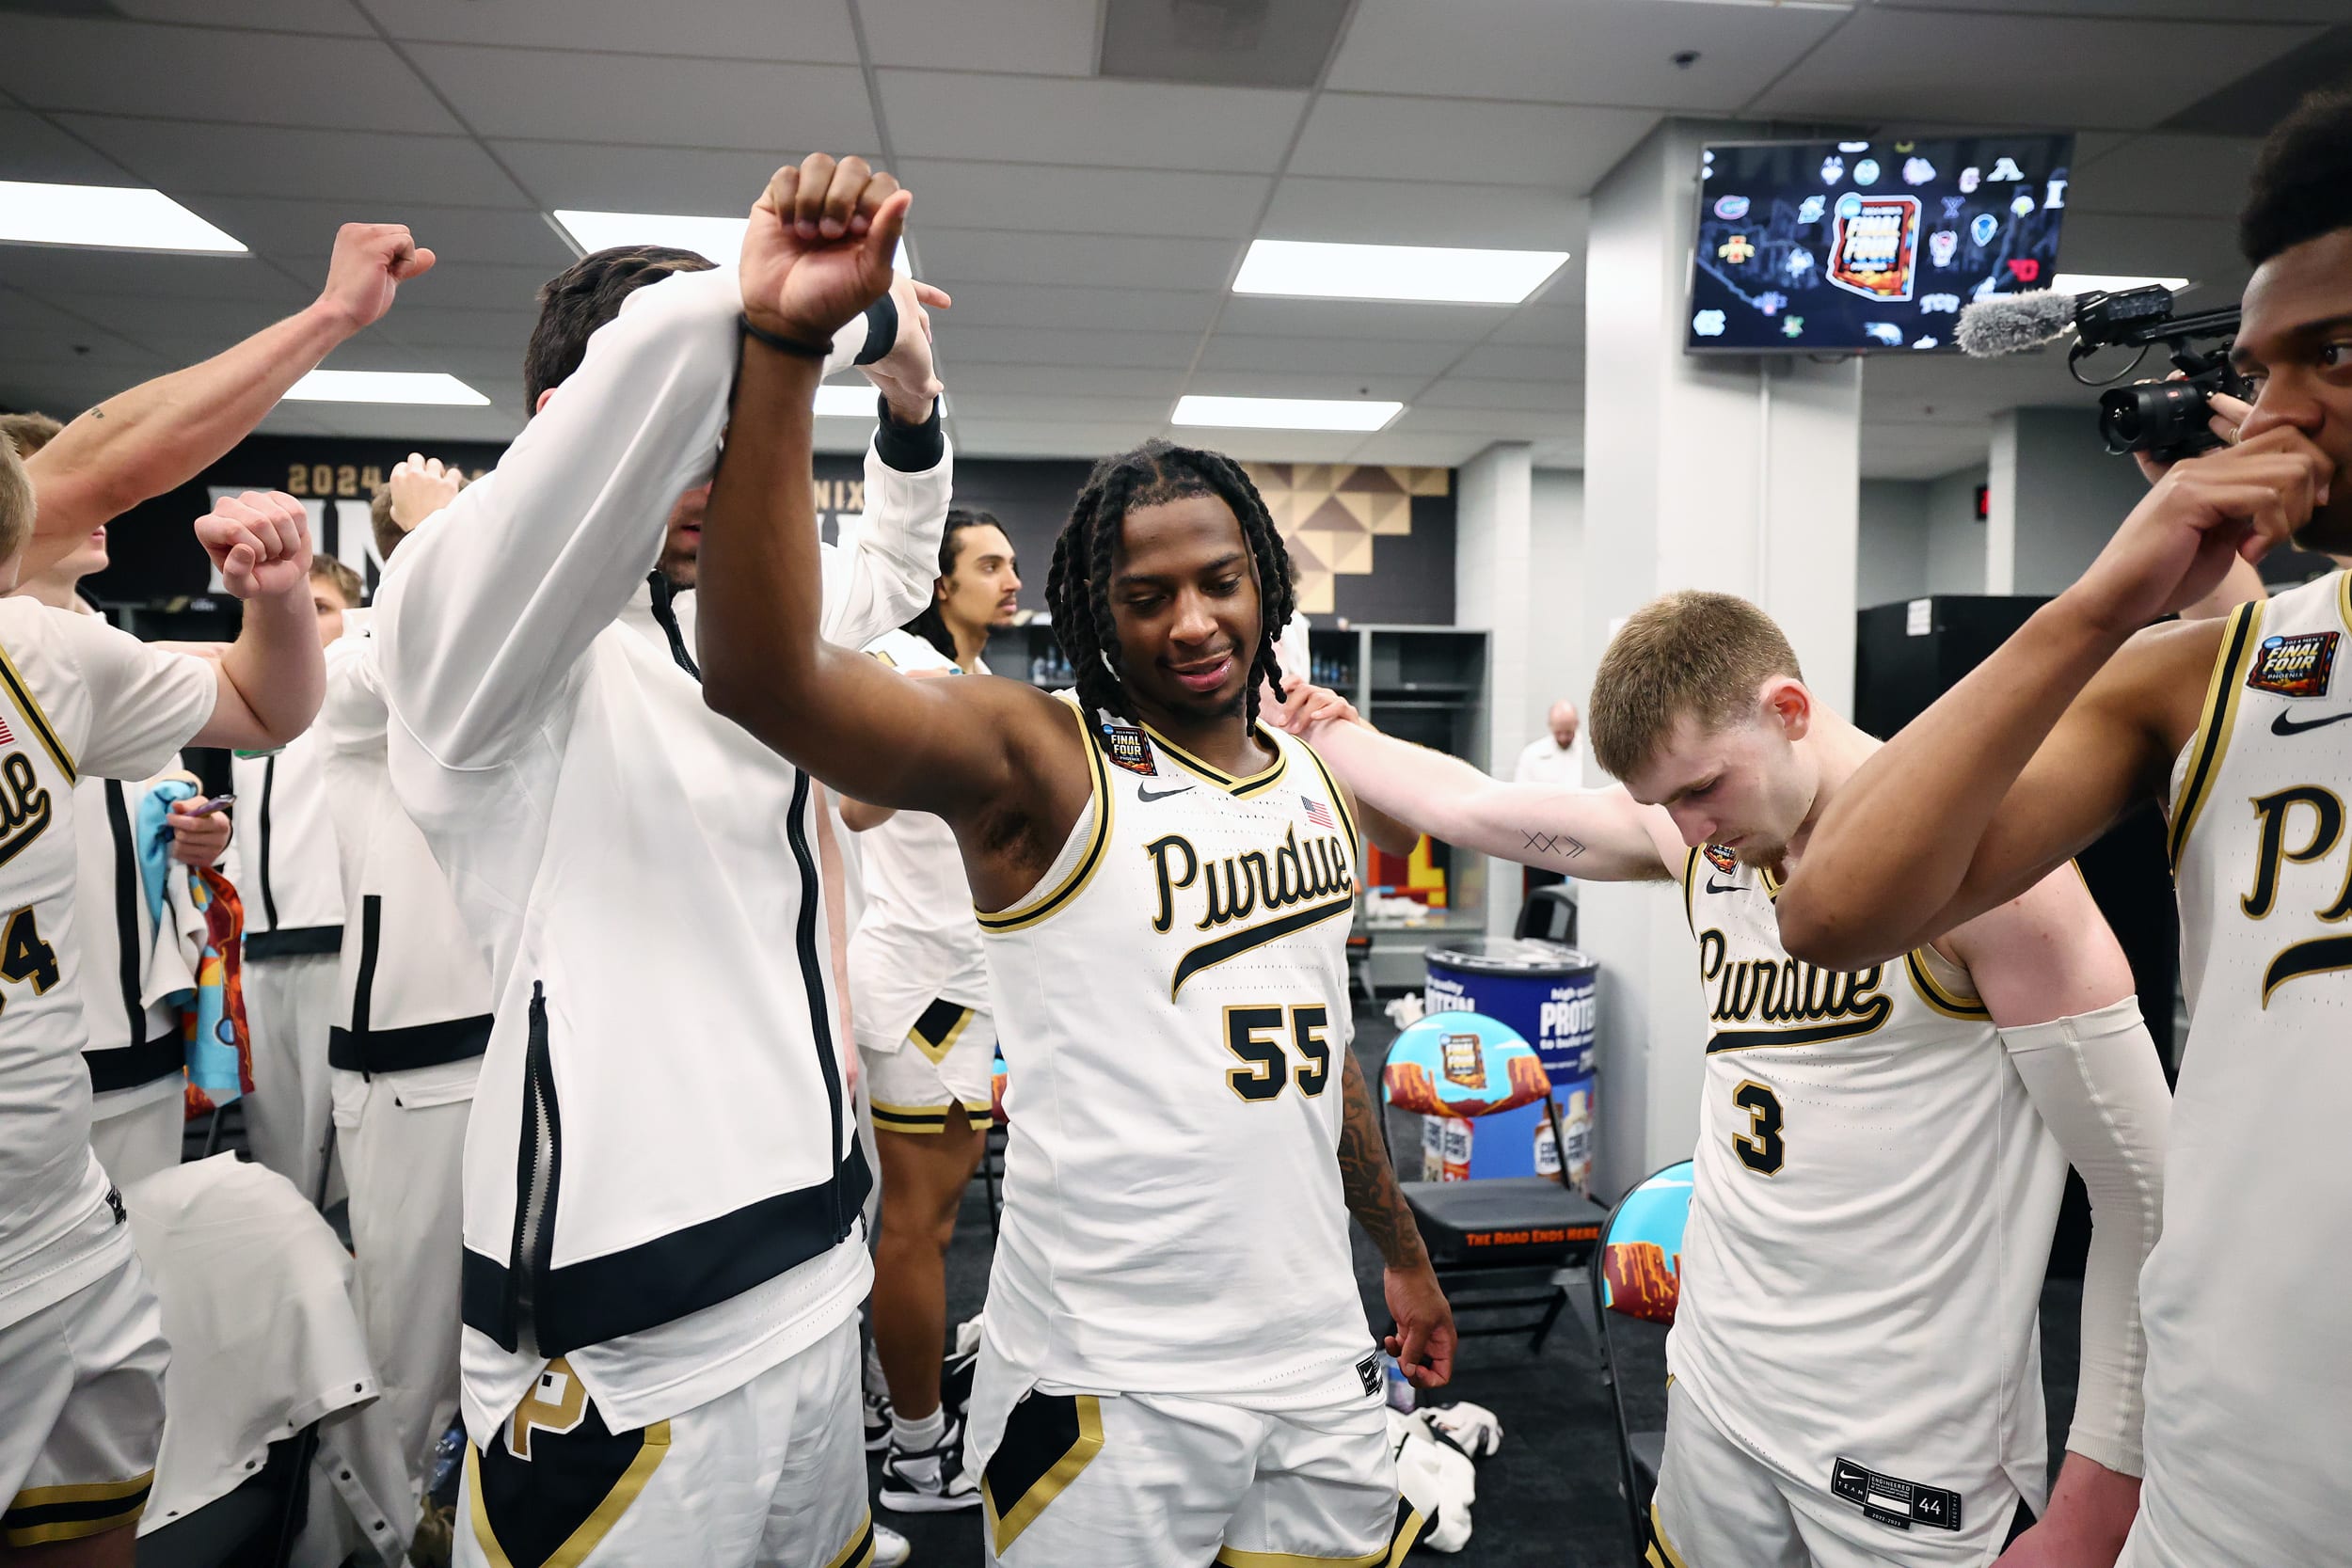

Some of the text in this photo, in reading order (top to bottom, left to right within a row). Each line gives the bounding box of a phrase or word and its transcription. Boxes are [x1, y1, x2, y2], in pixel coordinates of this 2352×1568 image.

[288, 464, 382, 498] 2024
[2267, 642, 2320, 659] FINAL
[2263, 656, 2315, 673] FOUR
[1110, 735, 1140, 745] FINAL
[1113, 744, 1141, 755] FOUR
[1145, 821, 1352, 934] Purdue
[0, 904, 60, 1006] 4
[1223, 1004, 1329, 1102] 55
[1732, 1079, 1786, 1177] 3
[1466, 1227, 1599, 1246] THE ROAD ENDS HERE
[1838, 1481, 1864, 1496] TEAM
[1871, 1476, 1911, 1492] ENGINEERED
[1919, 1497, 1941, 1514] 44
